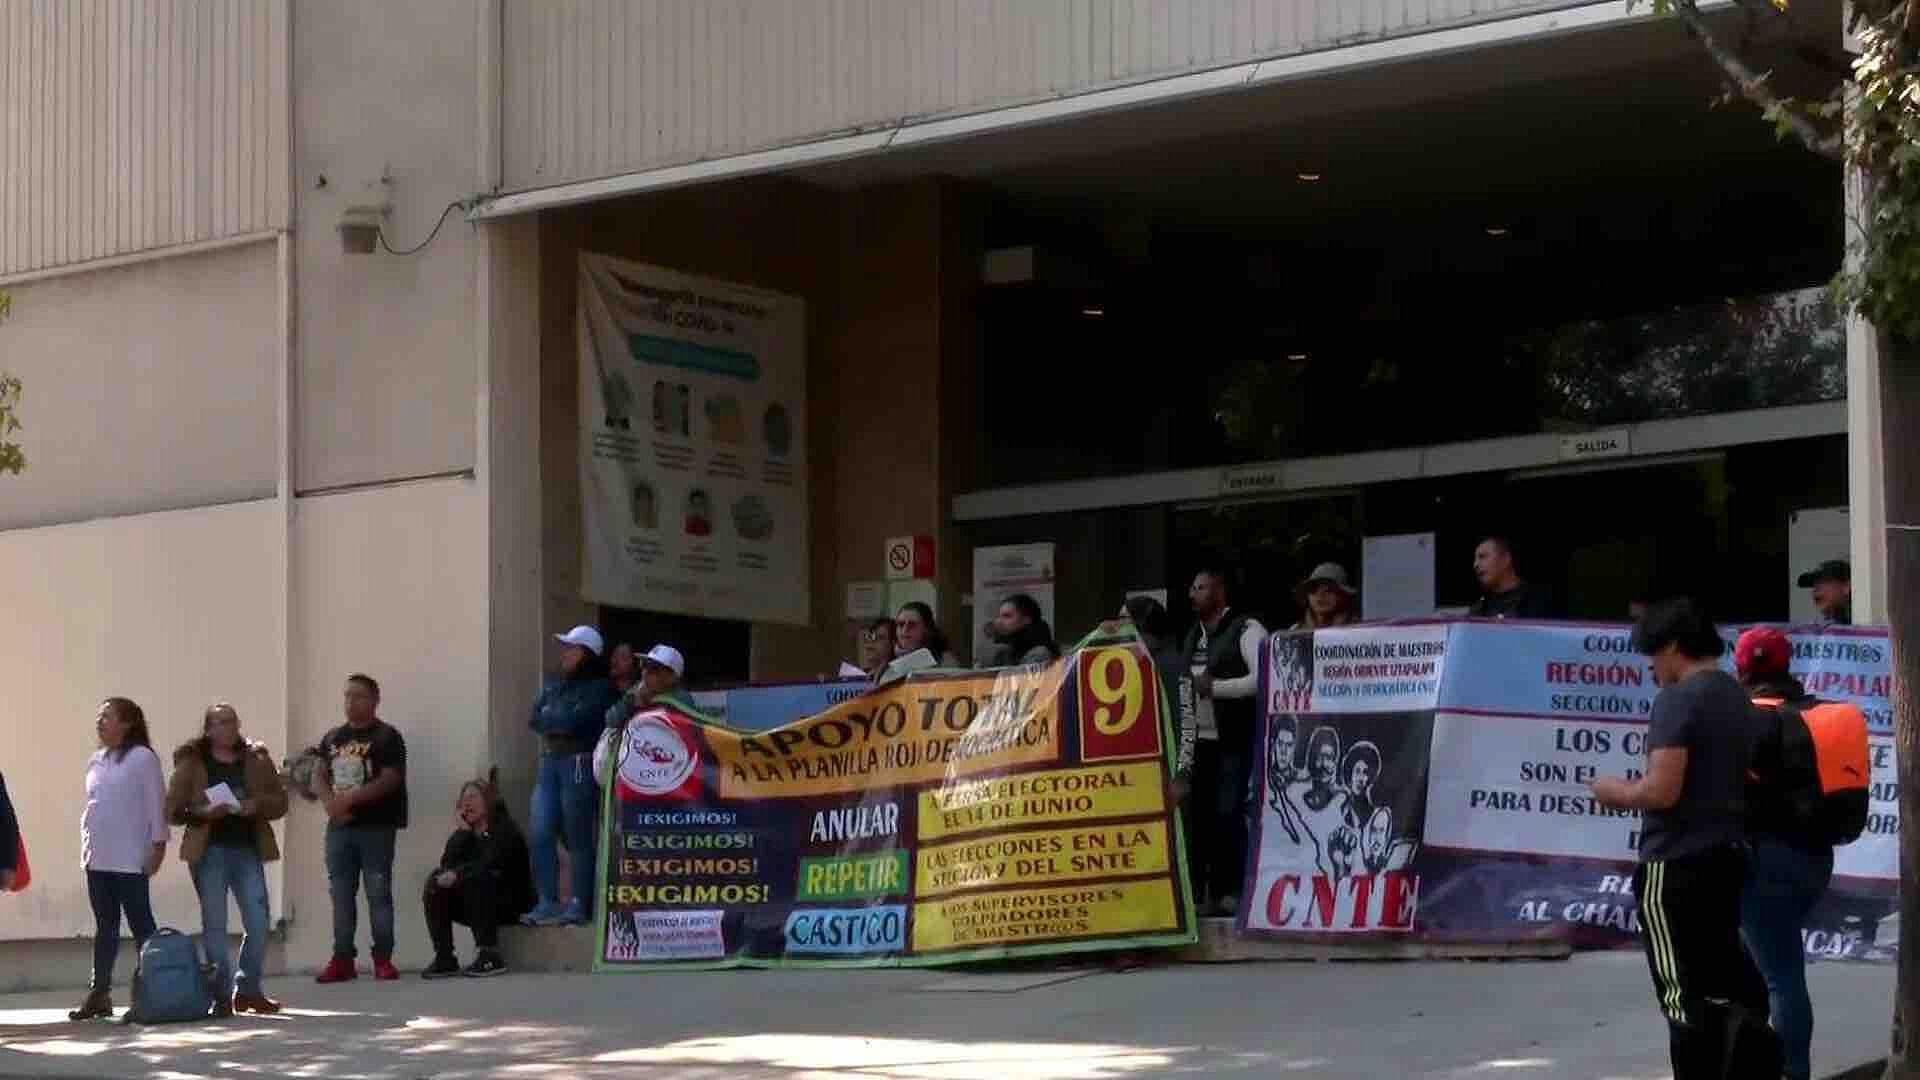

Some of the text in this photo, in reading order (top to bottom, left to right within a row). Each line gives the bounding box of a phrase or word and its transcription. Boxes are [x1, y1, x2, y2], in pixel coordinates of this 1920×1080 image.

[1545, 660, 1643, 688] REGIÓN
[1089, 647, 1143, 736] 9
[1550, 692, 1633, 714] SECCIÓN
[739, 701, 906, 758] APOYO
[1555, 727, 1612, 755] LOS
[732, 761, 748, 782] A
[750, 761, 784, 782] LA
[785, 746, 877, 780] PLANILLA
[1519, 761, 1567, 784] SON
[997, 772, 1136, 799] ELECTORAL
[991, 801, 1017, 820] DE
[1022, 794, 1094, 818] JUNIO
[1469, 789, 1532, 814] PARA
[809, 803, 899, 844] ANULAR
[1072, 833, 1105, 852] EN
[1117, 829, 1152, 849] LA
[806, 857, 898, 896] REPETIR
[1016, 857, 1058, 877] DEL
[1071, 851, 1137, 873] SNTE
[608, 883, 770, 904] ¡EXIGIMOS!
[973, 889, 1124, 913] SUPERVISORES
[1263, 868, 1419, 930] CNTE
[1518, 901, 1553, 921] AL
